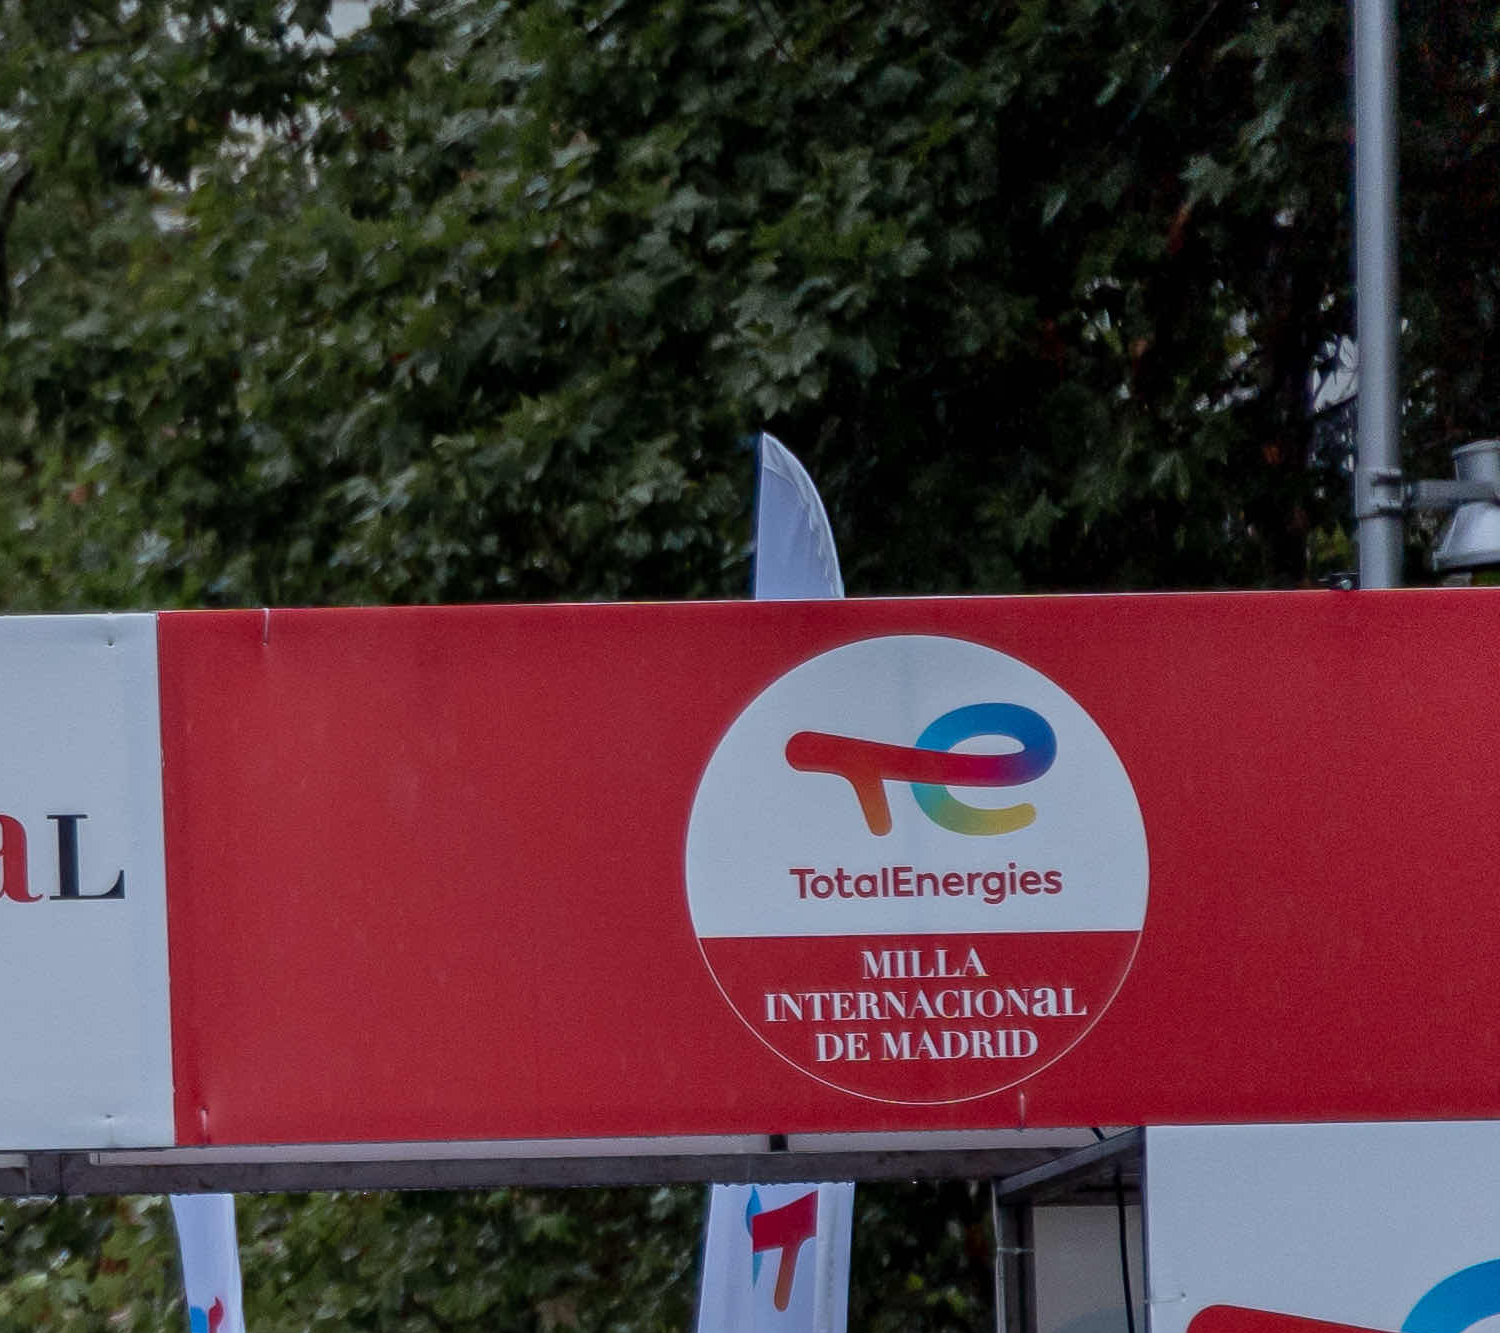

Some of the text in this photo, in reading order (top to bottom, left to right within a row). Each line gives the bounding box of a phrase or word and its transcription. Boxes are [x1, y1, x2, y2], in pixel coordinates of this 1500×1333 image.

[790, 863, 1062, 904] TotalEnergies
[863, 949, 986, 979] MILLA
[816, 1030, 1037, 1061] DE MADRID
